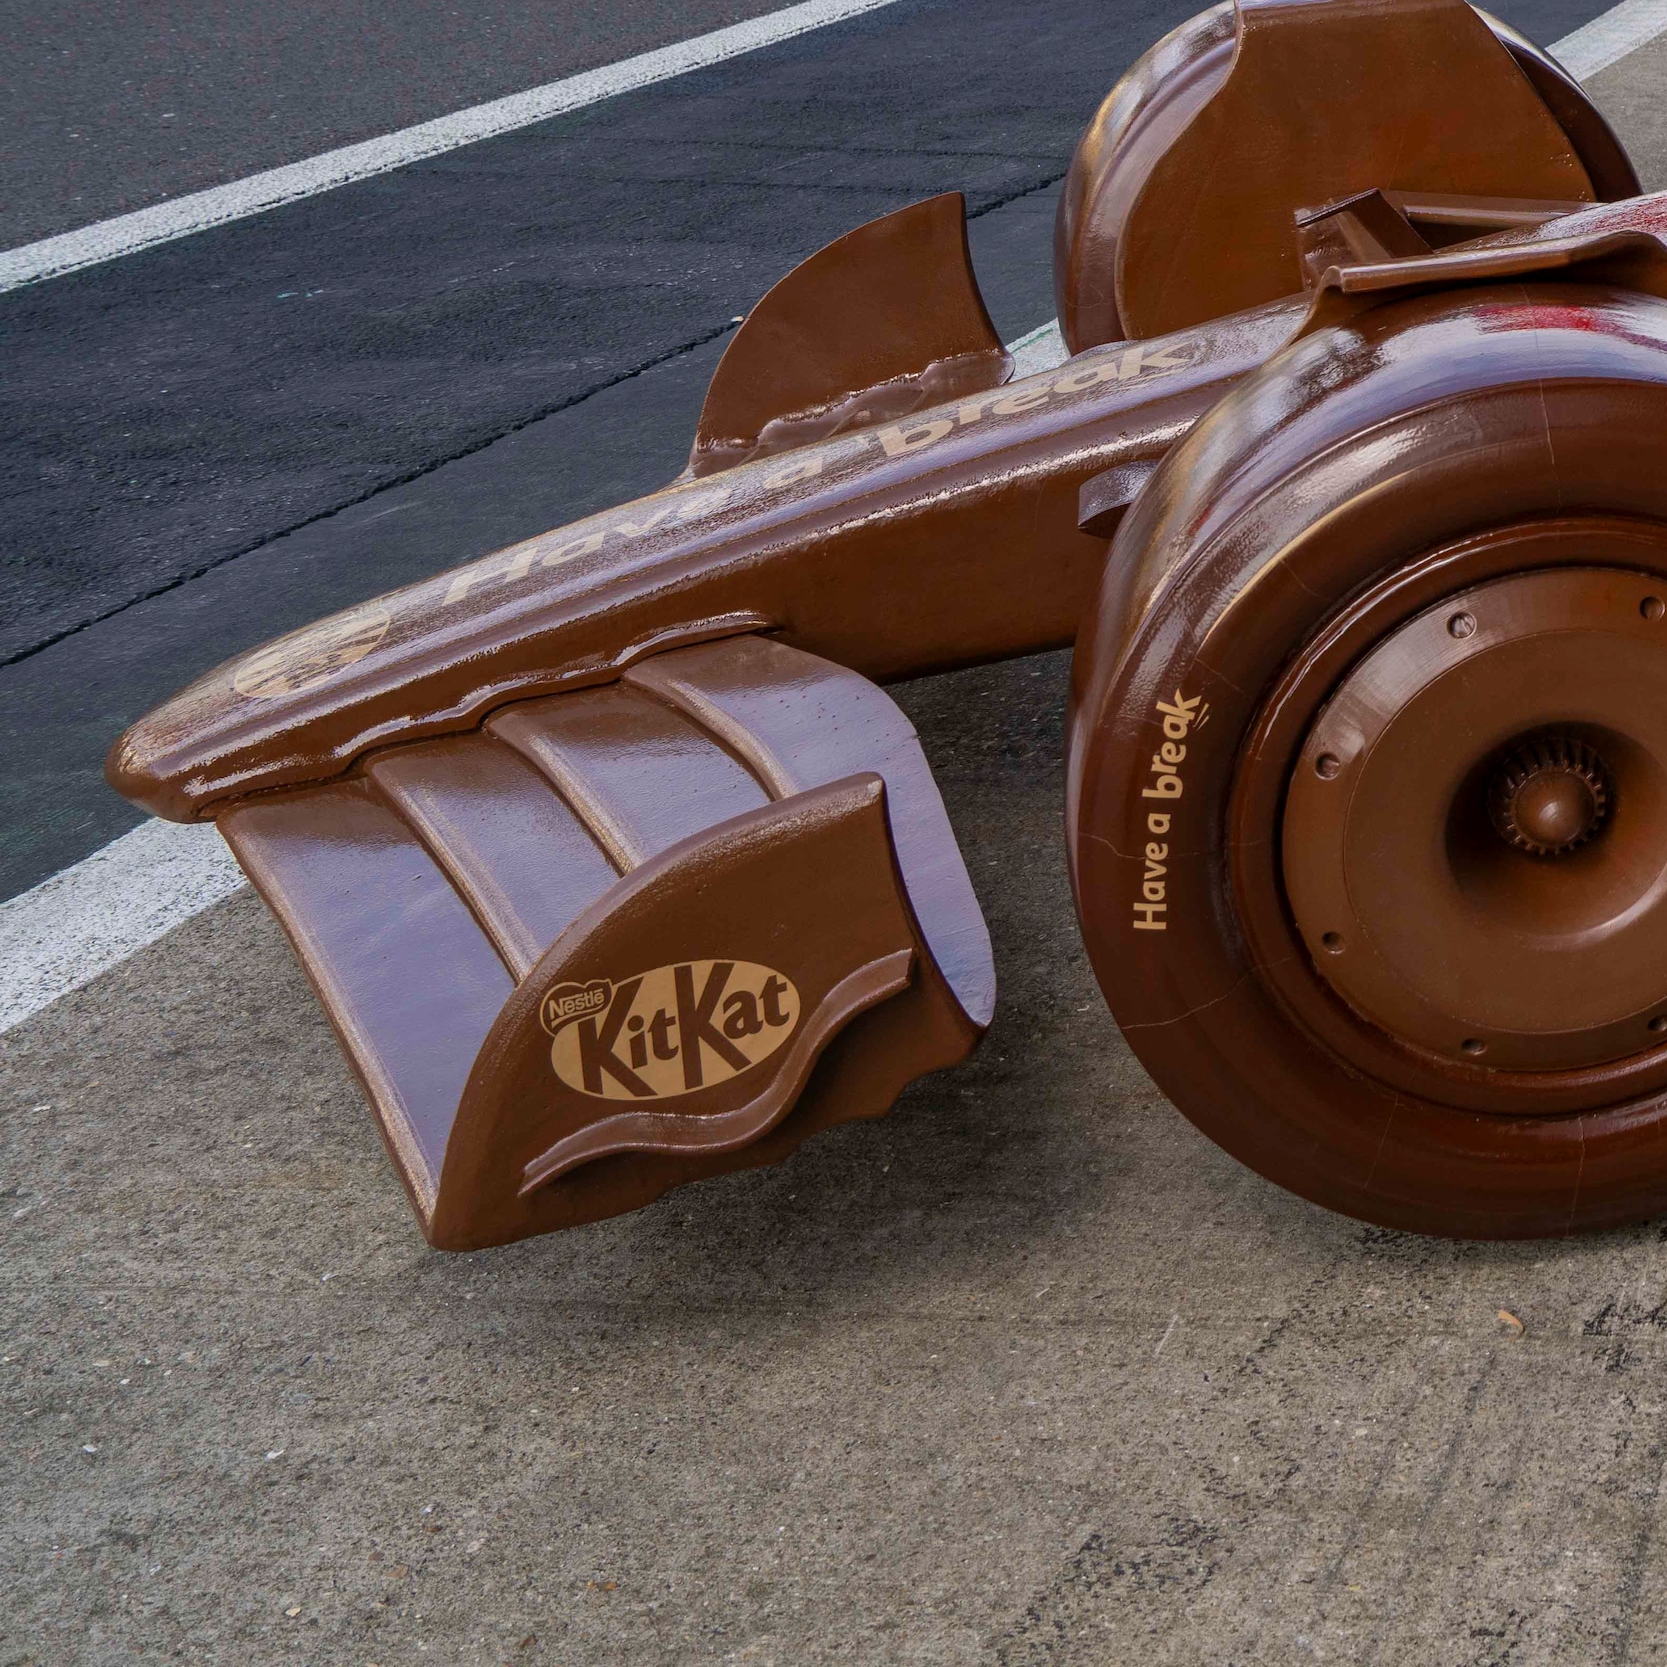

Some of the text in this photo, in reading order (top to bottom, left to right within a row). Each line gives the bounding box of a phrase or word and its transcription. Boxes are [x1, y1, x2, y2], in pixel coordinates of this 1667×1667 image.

[874, 342, 1197, 458] break
[1133, 688, 1202, 930] Have a break
[548, 987, 606, 1020] Nestlé
[577, 961, 791, 1097] KitKat
